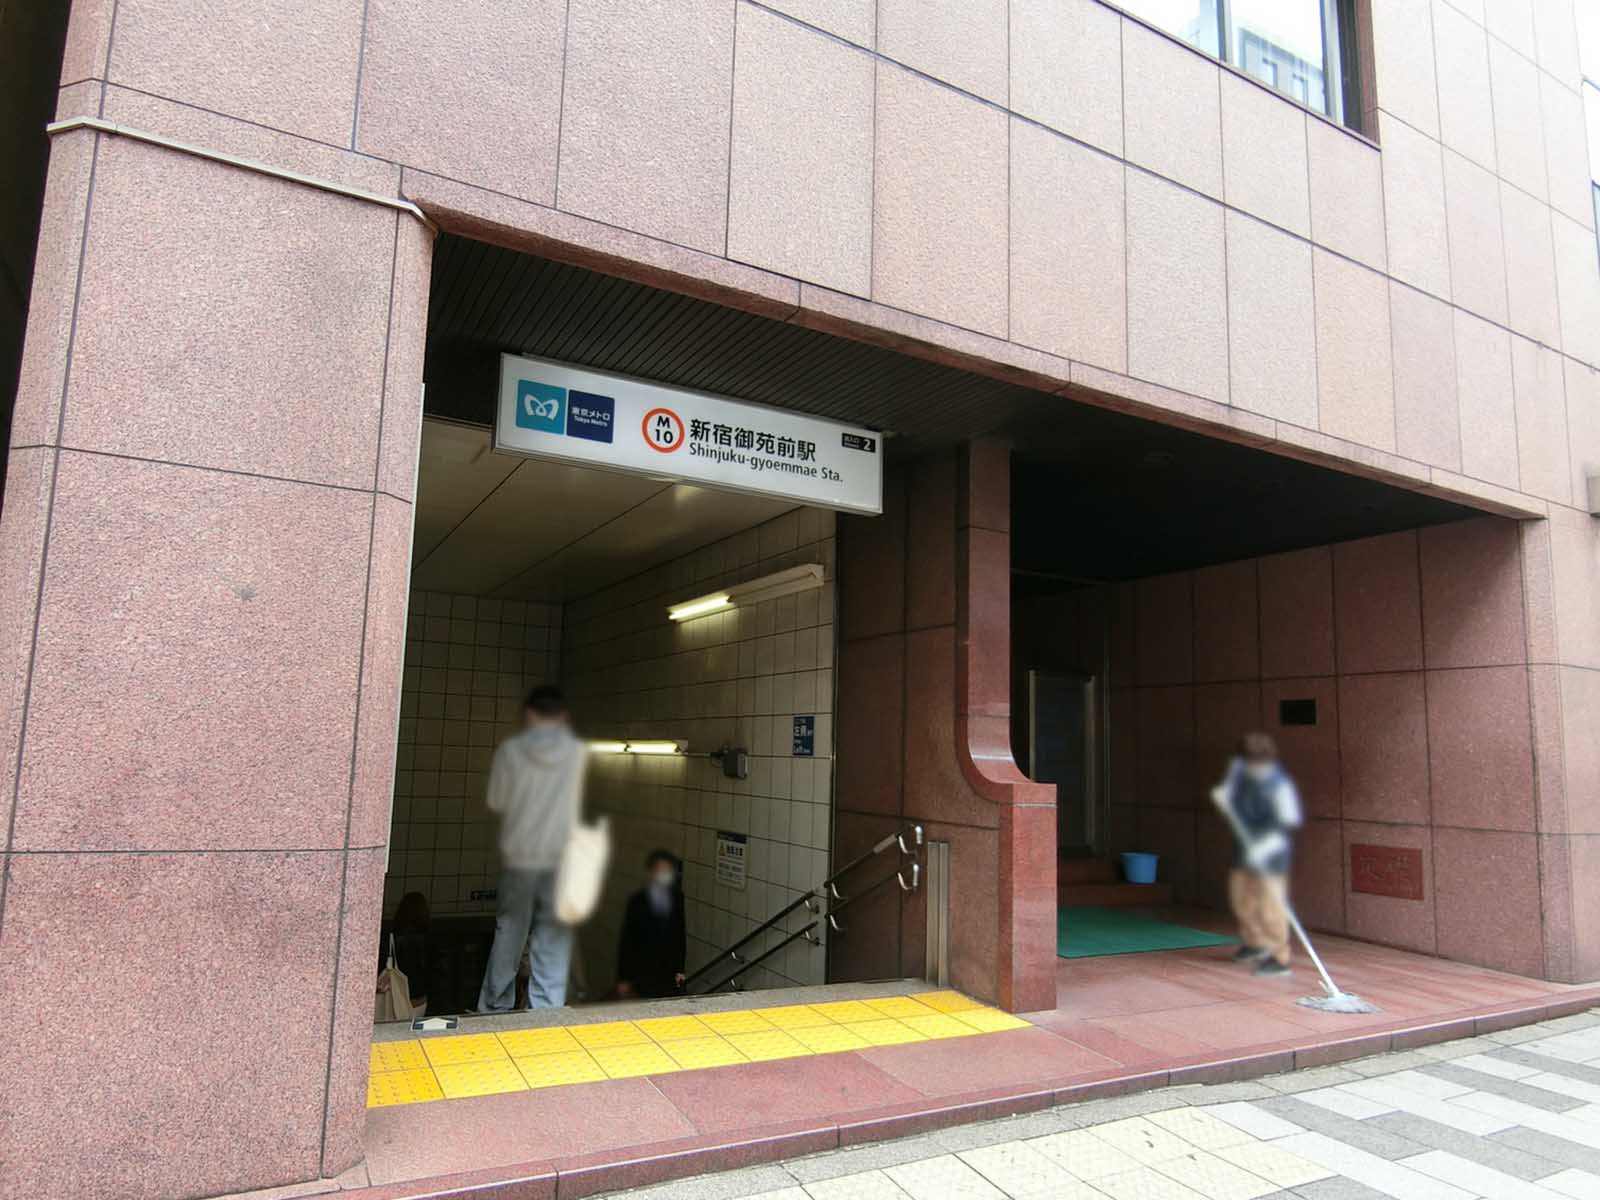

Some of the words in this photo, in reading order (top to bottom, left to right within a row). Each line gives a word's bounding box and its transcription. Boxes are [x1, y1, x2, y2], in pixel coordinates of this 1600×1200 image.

[657, 415, 670, 429] M
[655, 428, 674, 444] 10
[689, 418, 816, 462] 新宿御苑前駅
[863, 438, 872, 451] 2
[689, 442, 817, 477] Shinjuku-gyoemmae
[821, 467, 843, 483] Sta.
